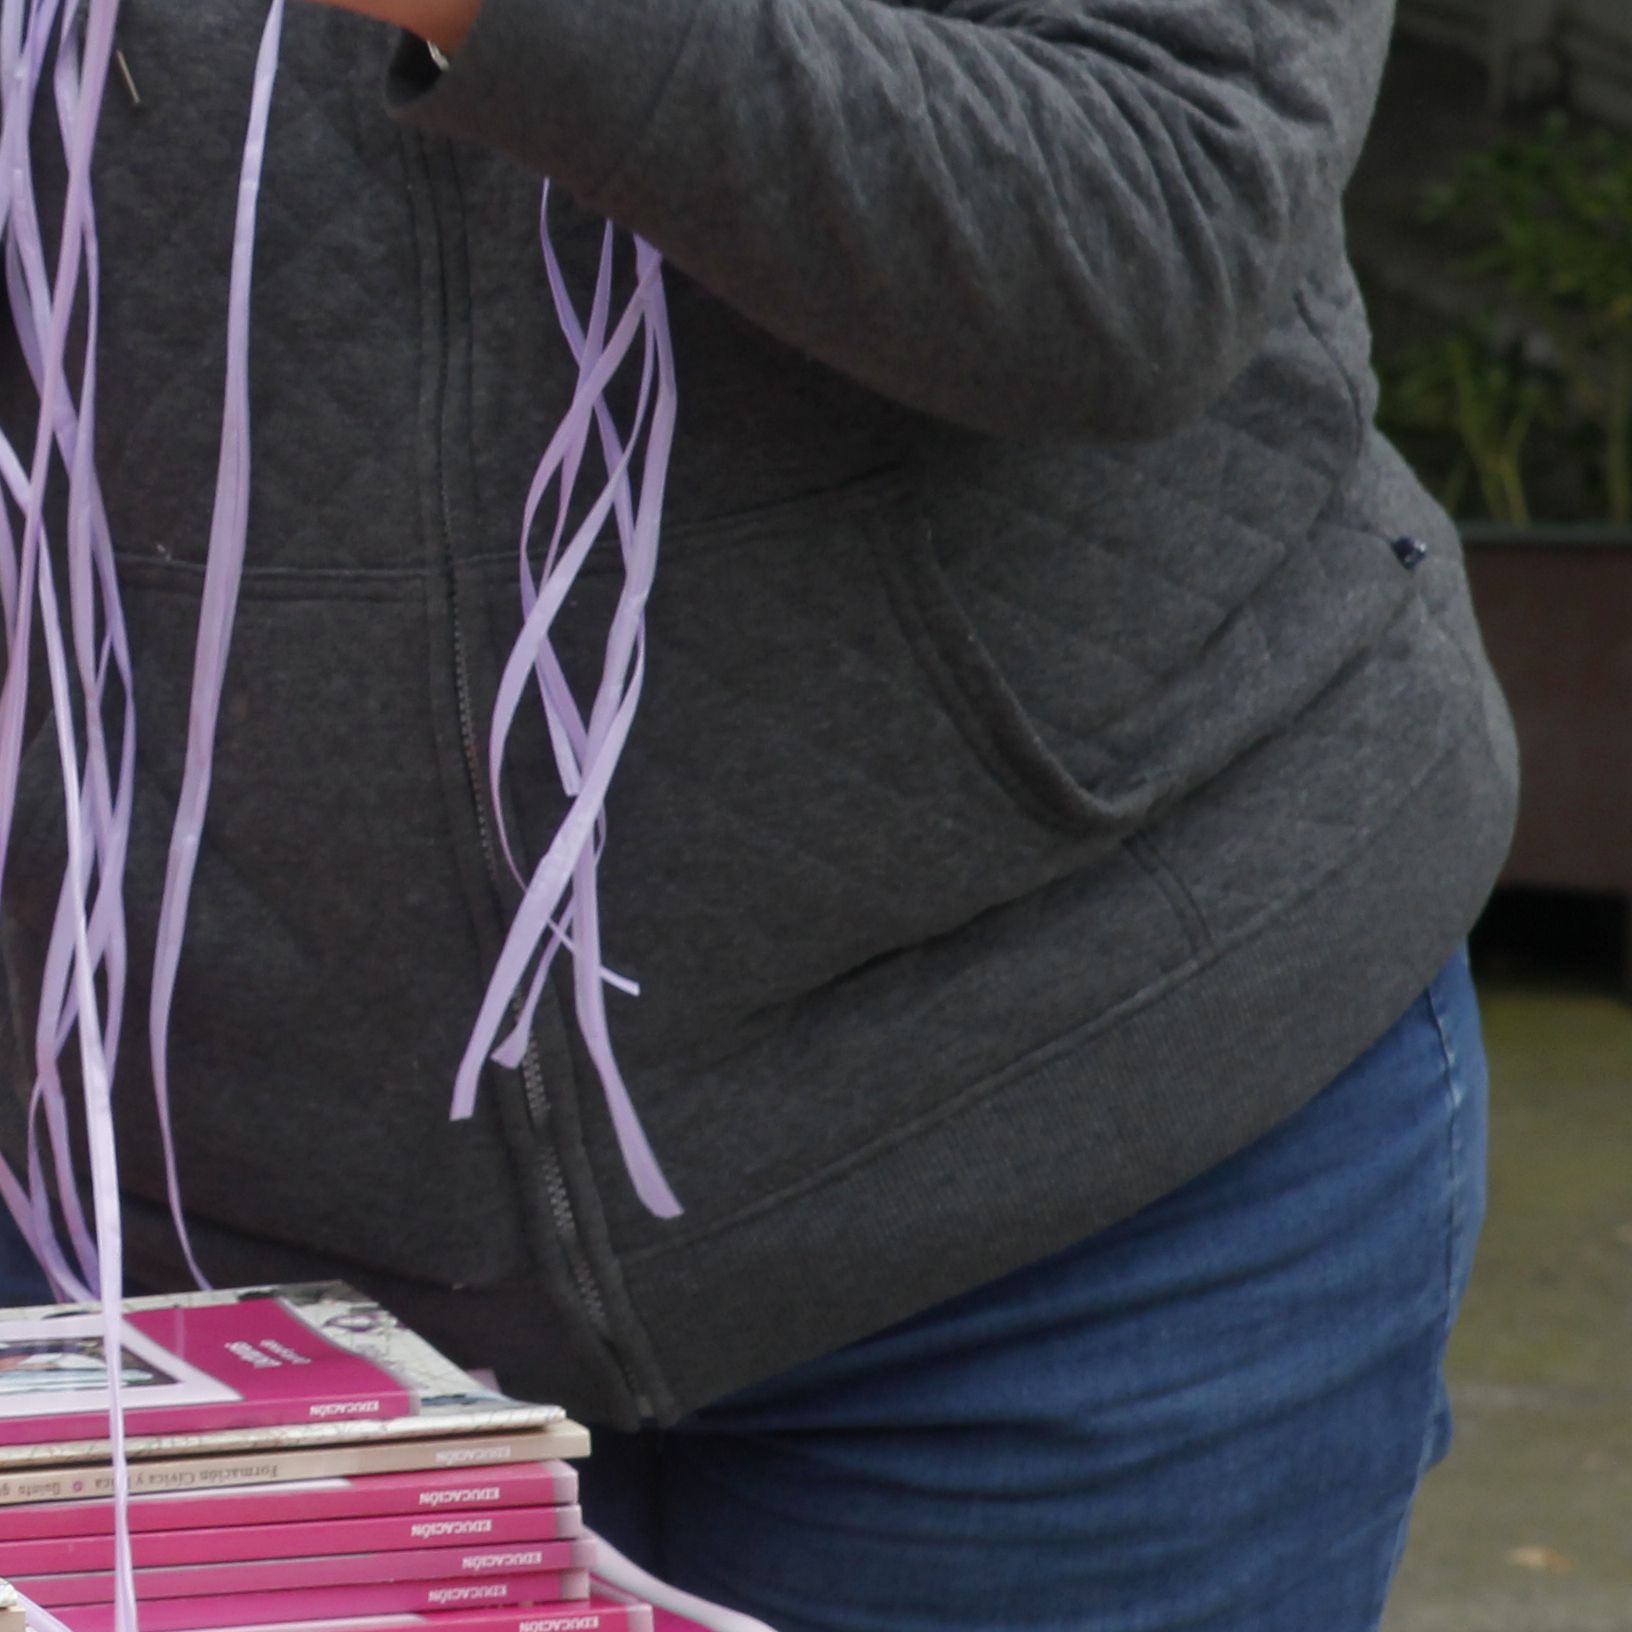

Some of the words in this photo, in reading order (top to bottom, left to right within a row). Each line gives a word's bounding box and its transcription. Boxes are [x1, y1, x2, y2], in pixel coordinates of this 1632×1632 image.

[419, 1487, 501, 1507] EDUCACIÓN
[411, 1519, 493, 1539] EDUCACIÓN
[462, 1551, 543, 1571] EDUCACIÓN
[428, 1584, 508, 1604] EDUCACIÓN
